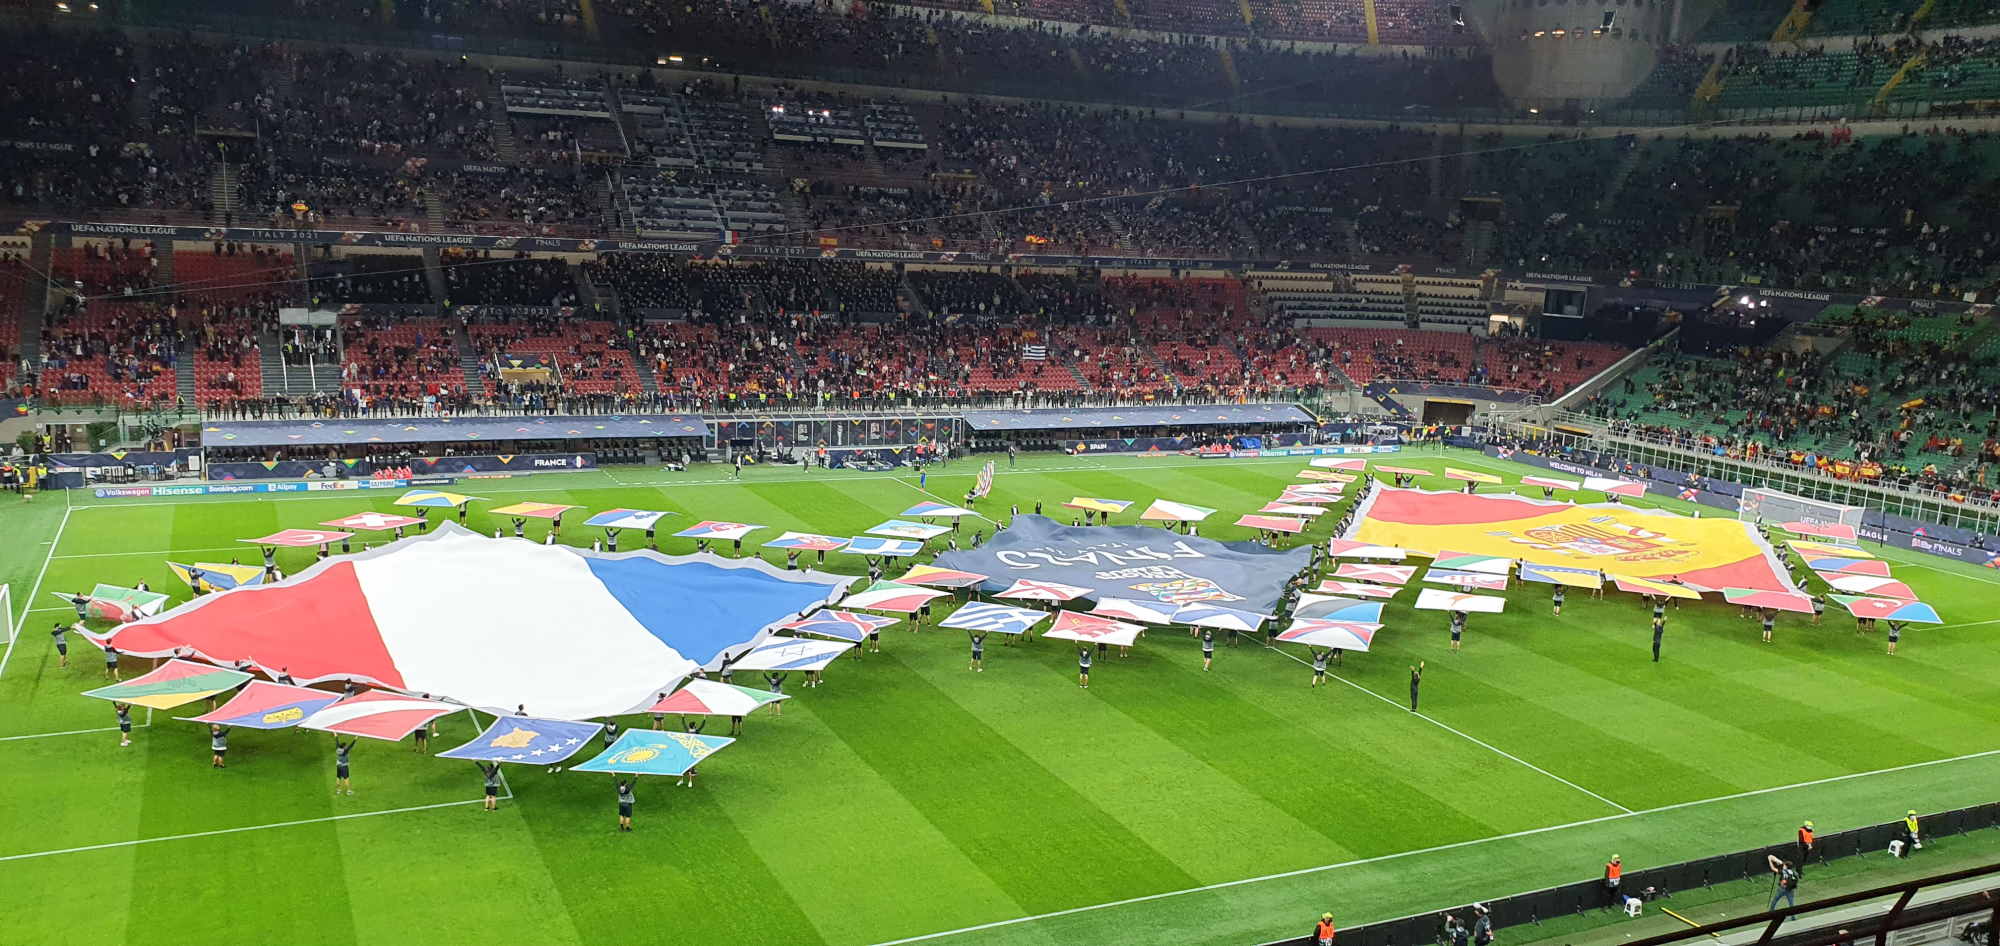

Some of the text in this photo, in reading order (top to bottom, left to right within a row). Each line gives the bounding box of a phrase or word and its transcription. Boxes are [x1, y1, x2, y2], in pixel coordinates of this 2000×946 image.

[71, 224, 177, 235] UEFA NATIONS LEAGUE
[251, 230, 285, 239] ITALY
[406, 235, 441, 243] NATIONS
[442, 236, 473, 244] LEAGUE
[535, 239, 561, 247] FINALS
[638, 242, 669, 250] NATIONS
[670, 243, 698, 251] LEAGUE
[855, 249, 924, 259] UEFA NATIONS LEAGUE
[1775, 290, 1803, 298] NATIONS
[1803, 292, 1830, 300] LEAGUE
[1549, 462, 1576, 473] WELCOME
[1577, 466, 1585, 474] TO
[106, 488, 149, 496] Volkswagen
[153, 487, 203, 495] Hisense
[208, 485, 253, 493] Booking.com
[1856, 529, 1888, 541] LEAGUE
[1933, 543, 1962, 556] FINALS
[996, 540, 1205, 570] FINALS
